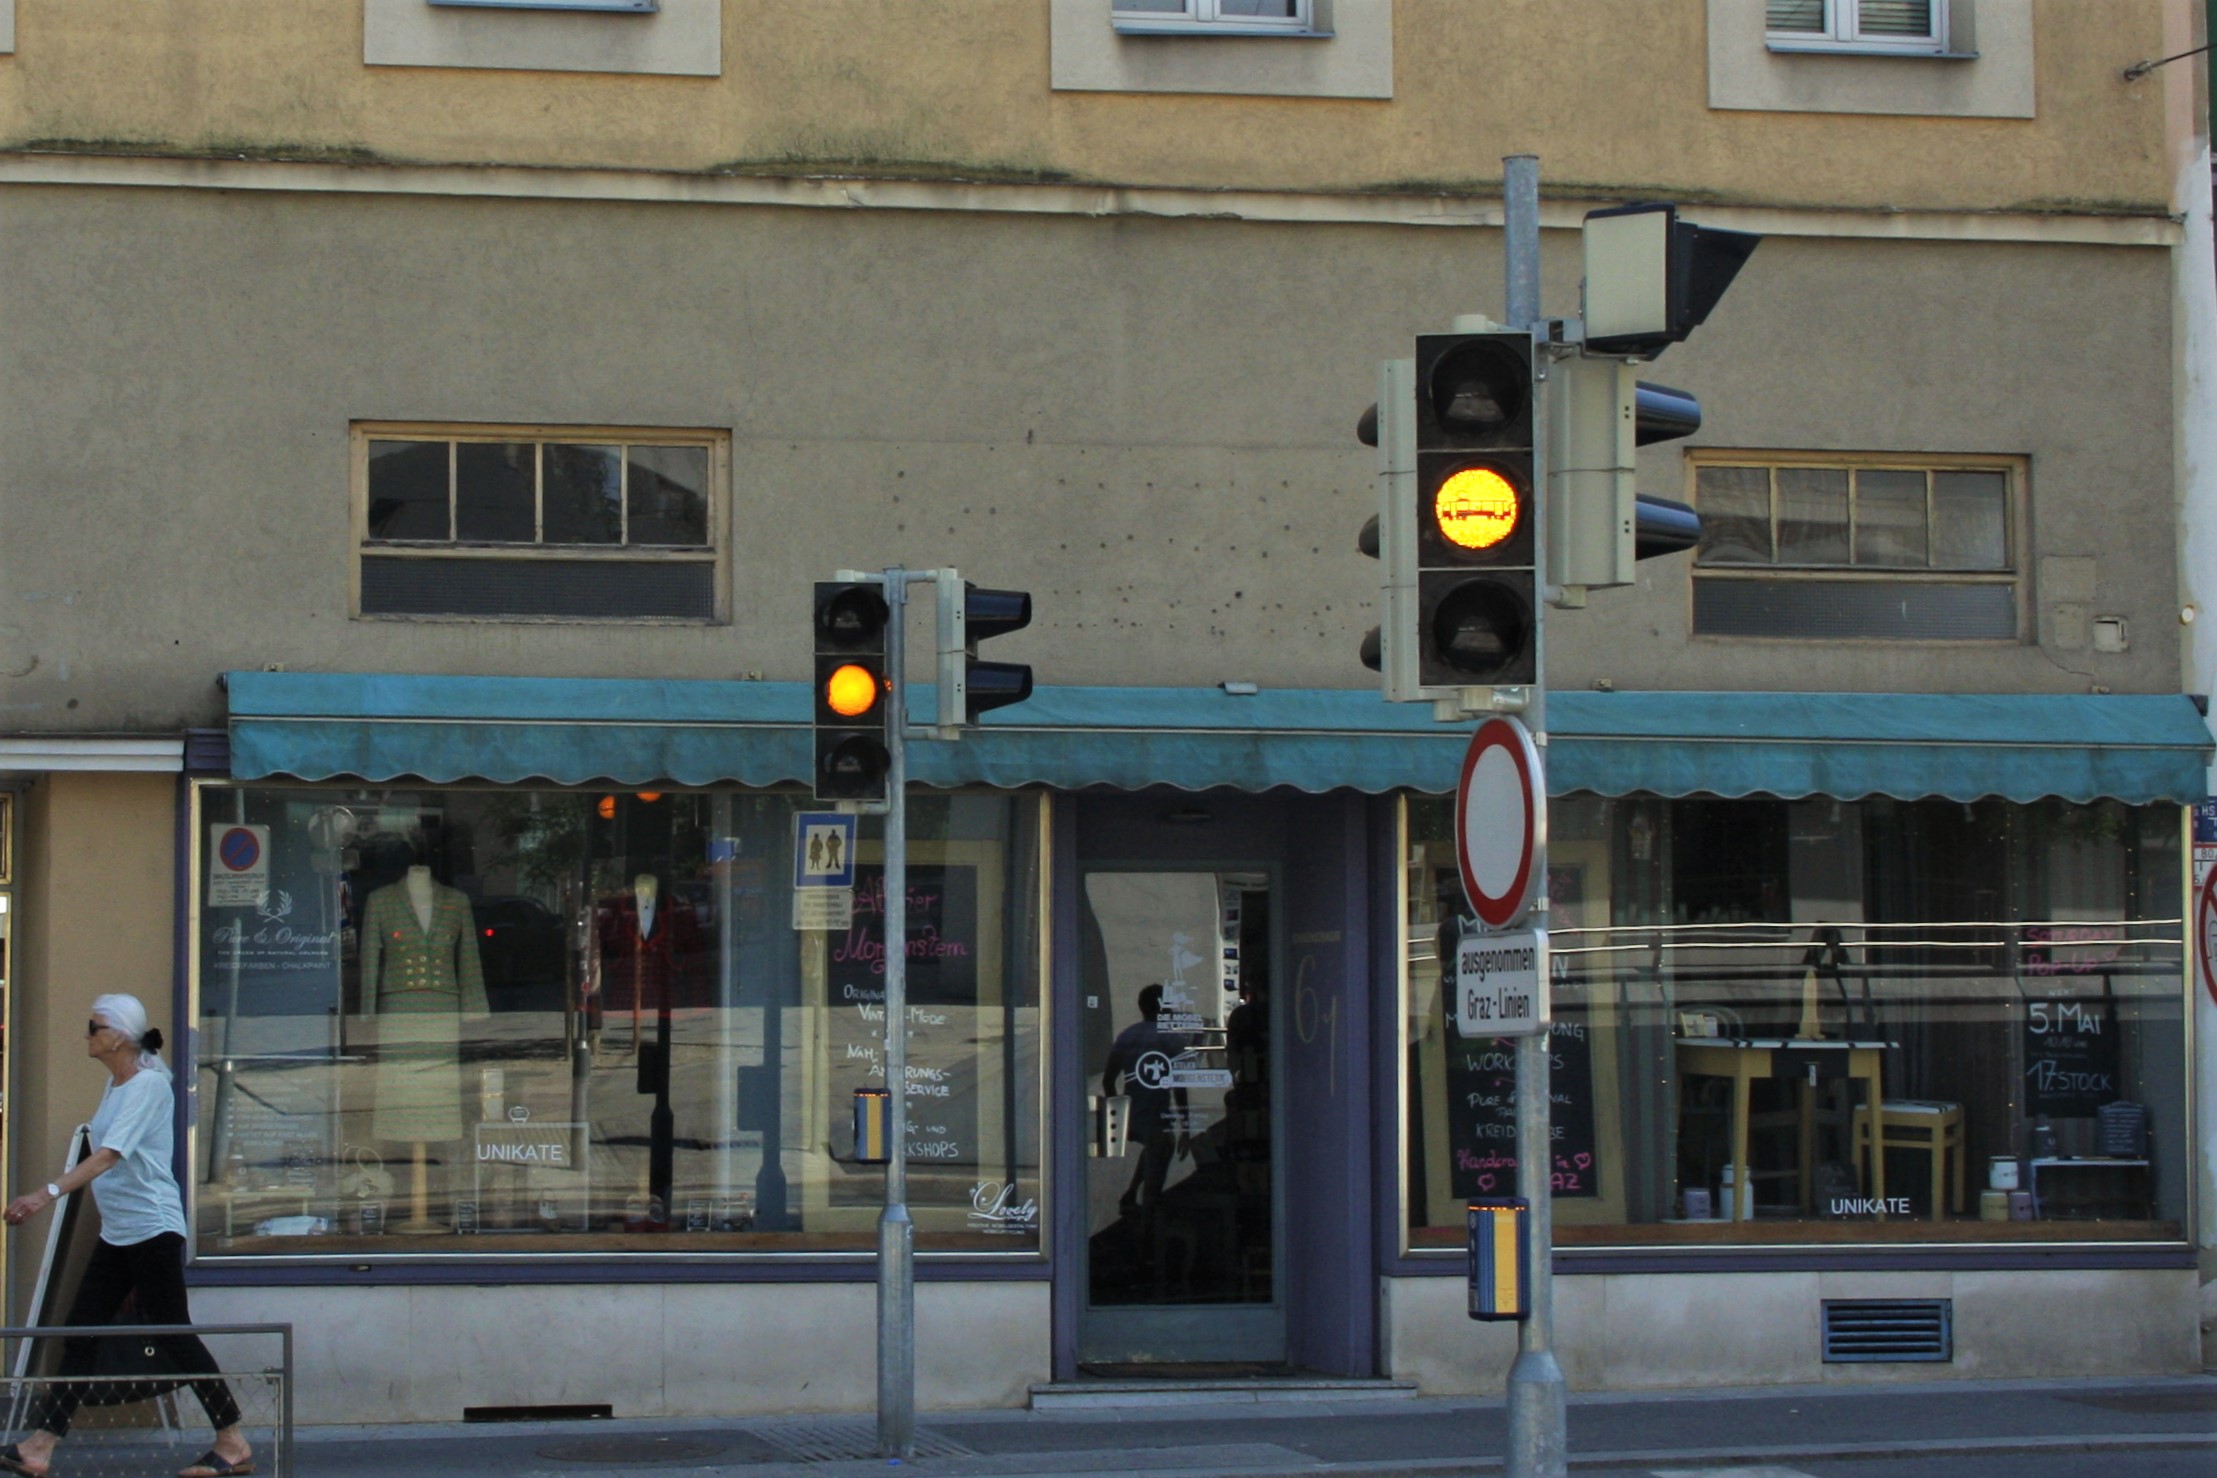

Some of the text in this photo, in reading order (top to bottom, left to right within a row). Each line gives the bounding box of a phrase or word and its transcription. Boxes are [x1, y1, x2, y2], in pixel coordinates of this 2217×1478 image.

[274, 926, 336, 951] Original
[1461, 946, 1535, 983] ausgenommen
[476, 1144, 564, 1161] UNIKATE
[967, 1181, 1039, 1222] Lovely
[1830, 1198, 1911, 1215] UNIKATE
